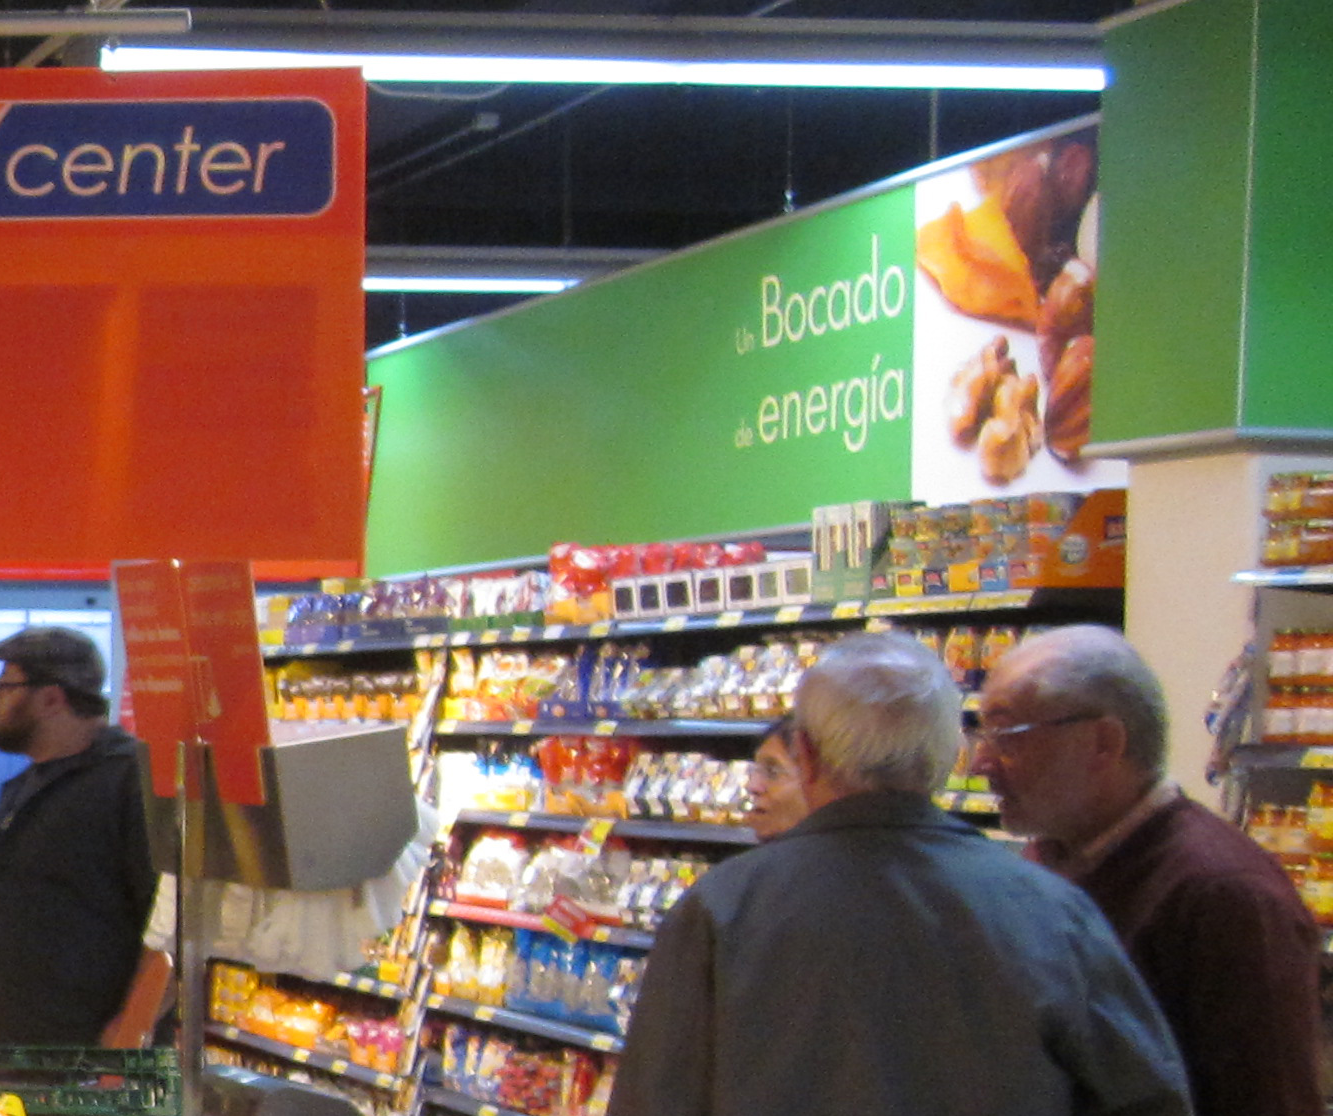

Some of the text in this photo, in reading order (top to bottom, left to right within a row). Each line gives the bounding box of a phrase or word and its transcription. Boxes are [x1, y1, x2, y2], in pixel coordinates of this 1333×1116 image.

[5, 126, 286, 197] center
[761, 234, 905, 347] Bocado
[758, 353, 905, 453] energía
